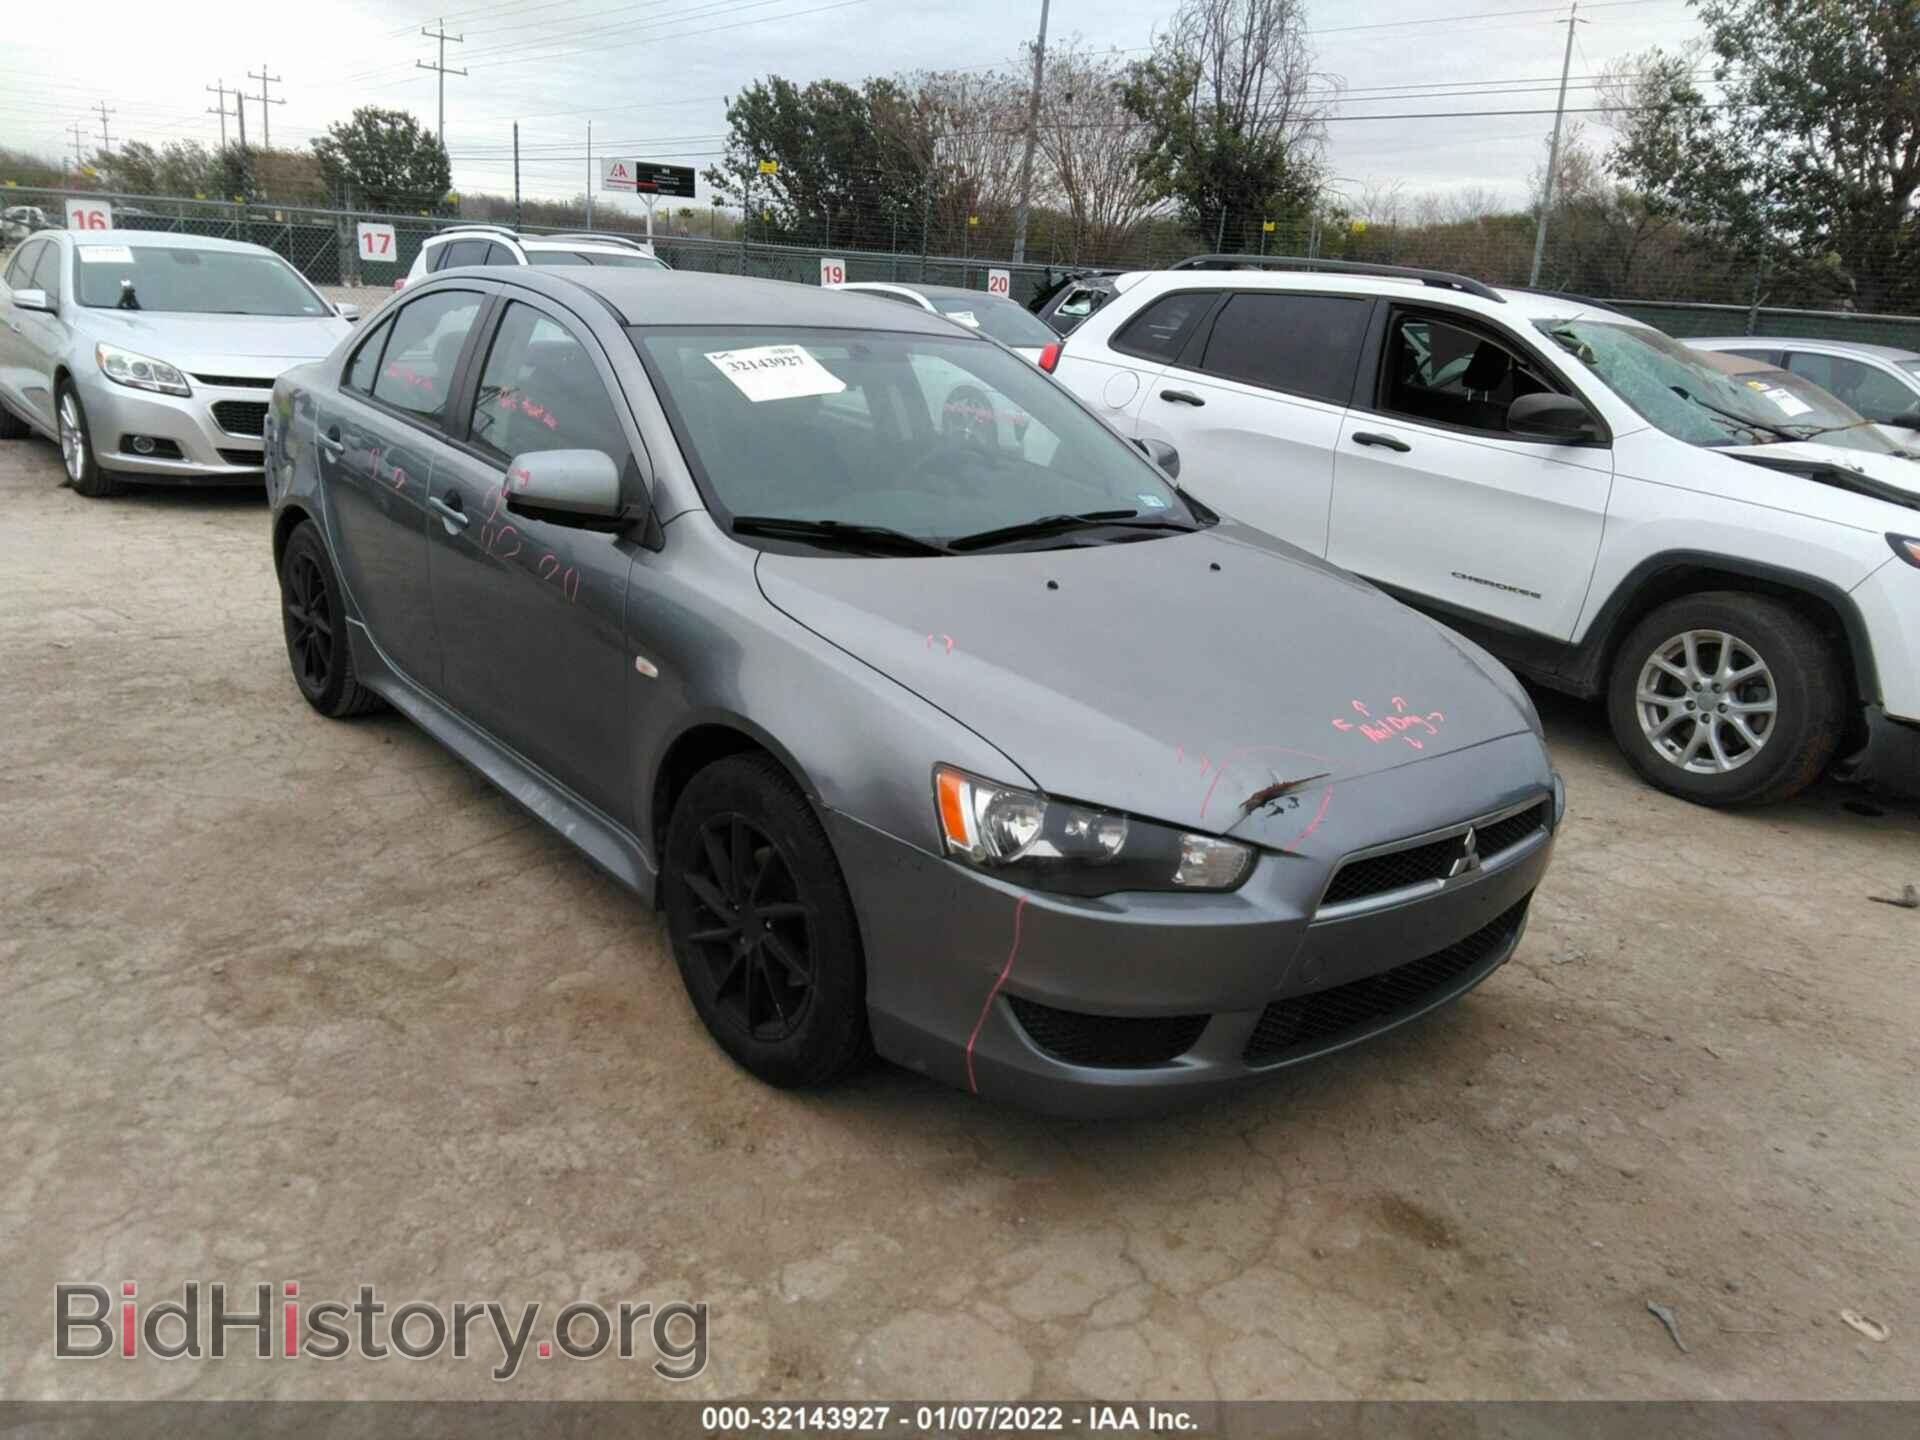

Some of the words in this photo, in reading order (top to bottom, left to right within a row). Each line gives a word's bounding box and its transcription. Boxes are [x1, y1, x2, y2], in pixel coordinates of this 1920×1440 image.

[71, 207, 107, 230] 16
[362, 232, 391, 254] 17
[823, 266, 842, 284] 19
[990, 276, 1008, 293] 20
[727, 355, 804, 372] 32143927
[1451, 571, 1542, 600] CHEROKEE
